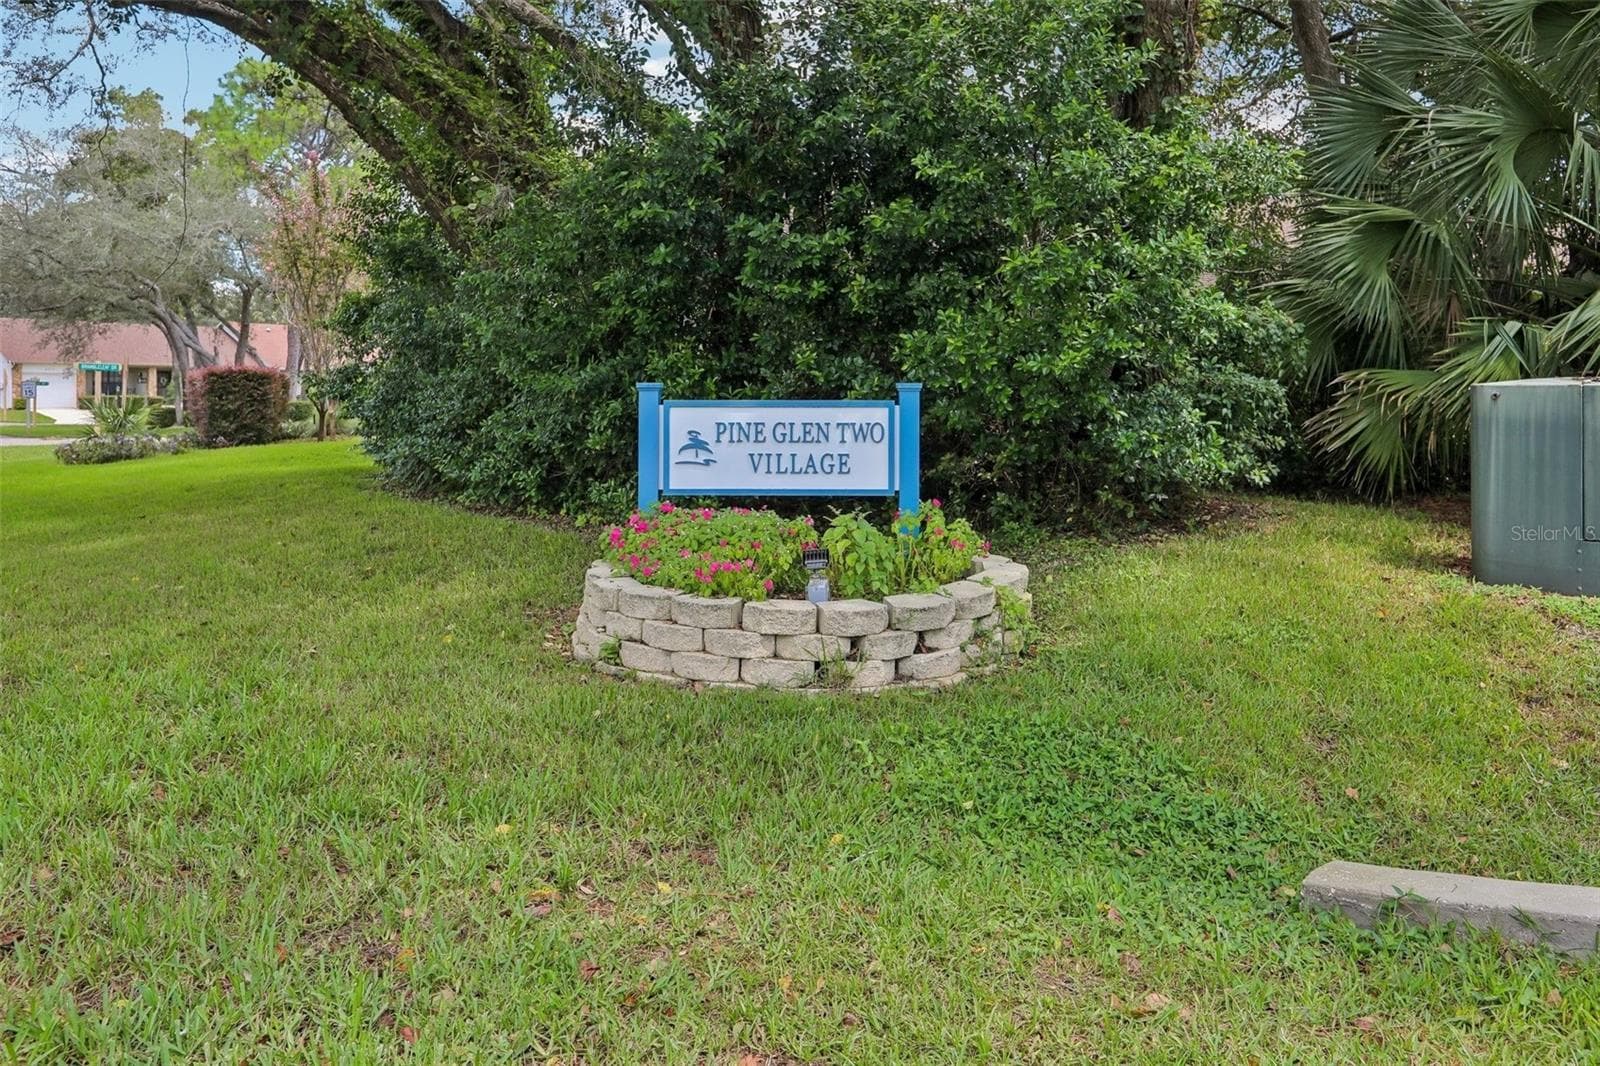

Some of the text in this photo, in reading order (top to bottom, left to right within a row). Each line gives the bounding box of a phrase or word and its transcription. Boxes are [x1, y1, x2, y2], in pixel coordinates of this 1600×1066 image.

[24, 389, 34, 397] 15
[715, 422, 885, 444] PINE GLEN TWO
[748, 453, 851, 475] VILLAGE
